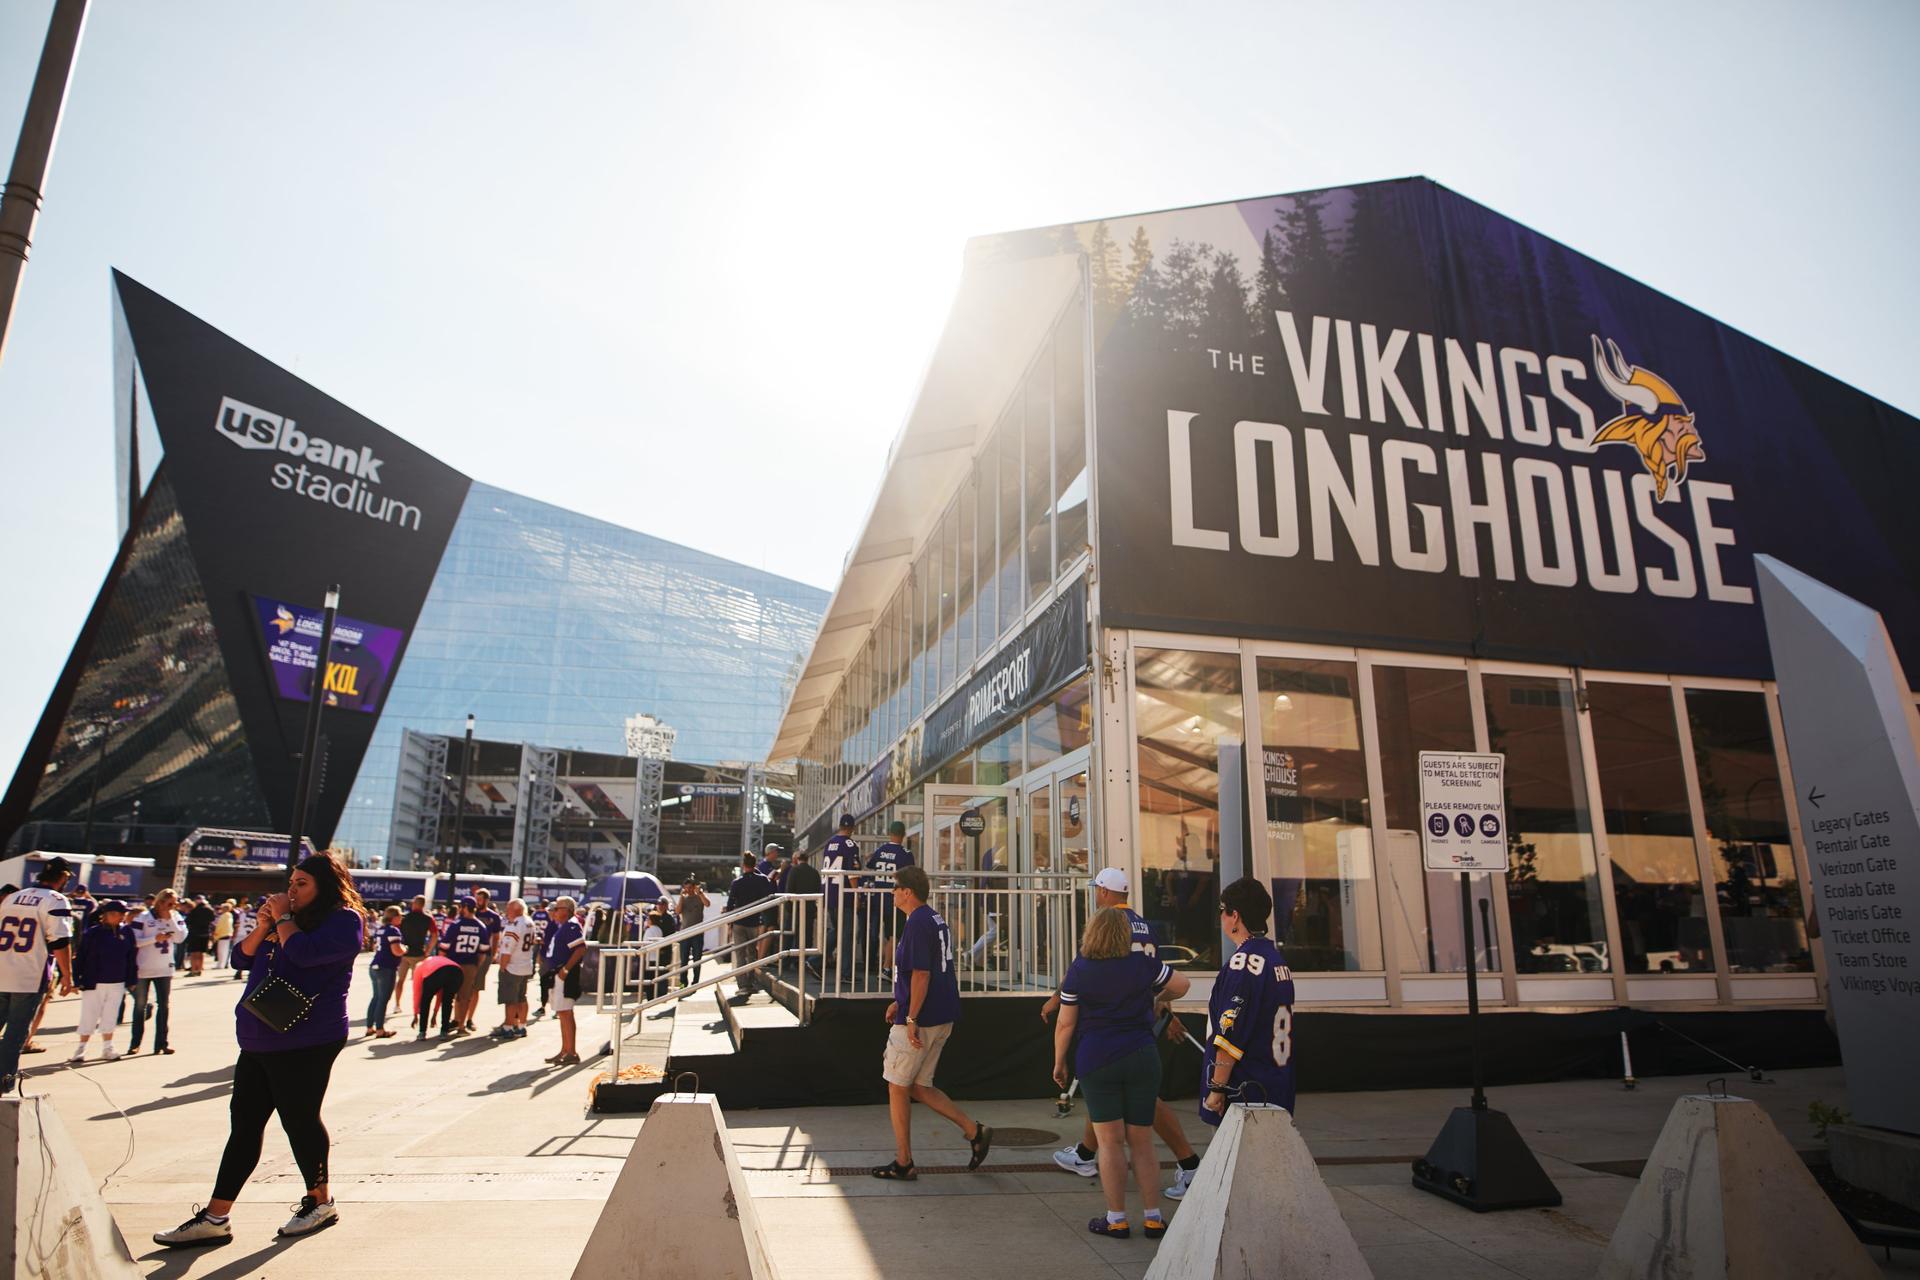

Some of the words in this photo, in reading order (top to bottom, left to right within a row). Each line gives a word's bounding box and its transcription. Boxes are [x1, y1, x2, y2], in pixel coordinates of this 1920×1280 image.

[1207, 348, 1265, 376] THE
[1275, 310, 1600, 454] VIKINGS
[271, 463, 422, 531] stadium
[1166, 409, 1755, 605] LONGHOUSE
[323, 661, 359, 696] KOL
[970, 648, 1030, 727] PRIMESPORT
[1263, 750, 1285, 767] KINGS
[1423, 761, 1450, 769] GUESTS
[1452, 761, 1466, 769] ARE
[1468, 762, 1498, 771] SUBJECT
[1264, 765, 1297, 785] GHOUSE
[1434, 770, 1458, 778] METAL
[1460, 771, 1499, 779] DETECTION
[697, 786, 740, 794] POLARIS
[1453, 803, 1481, 811] REMOVE
[1483, 803, 1501, 811] ONLY
[1811, 815, 1852, 835] Legacy
[1853, 810, 1890, 827] Gates
[251, 847, 279, 858] VIKINGS
[1815, 837, 1858, 854] Pentair
[1860, 834, 1891, 849] Gate
[1819, 861, 1864, 877] Verizon
[1866, 857, 1897, 873] Gate
[1824, 883, 1863, 899] Ecolab
[1866, 881, 1896, 896] Gate
[1828, 906, 1869, 921] Polaris
[1872, 904, 1903, 920] Gate
[0, 916, 37, 953] 69
[455, 934, 480, 953] 29
[1832, 929, 1869, 944] Ticket
[1872, 928, 1911, 943] Office
[1229, 952, 1265, 977] 89
[1836, 953, 1870, 968] Team
[1872, 952, 1908, 968] Store
[1840, 976, 1888, 996] Vikings
[1272, 1005, 1292, 1067] 8
